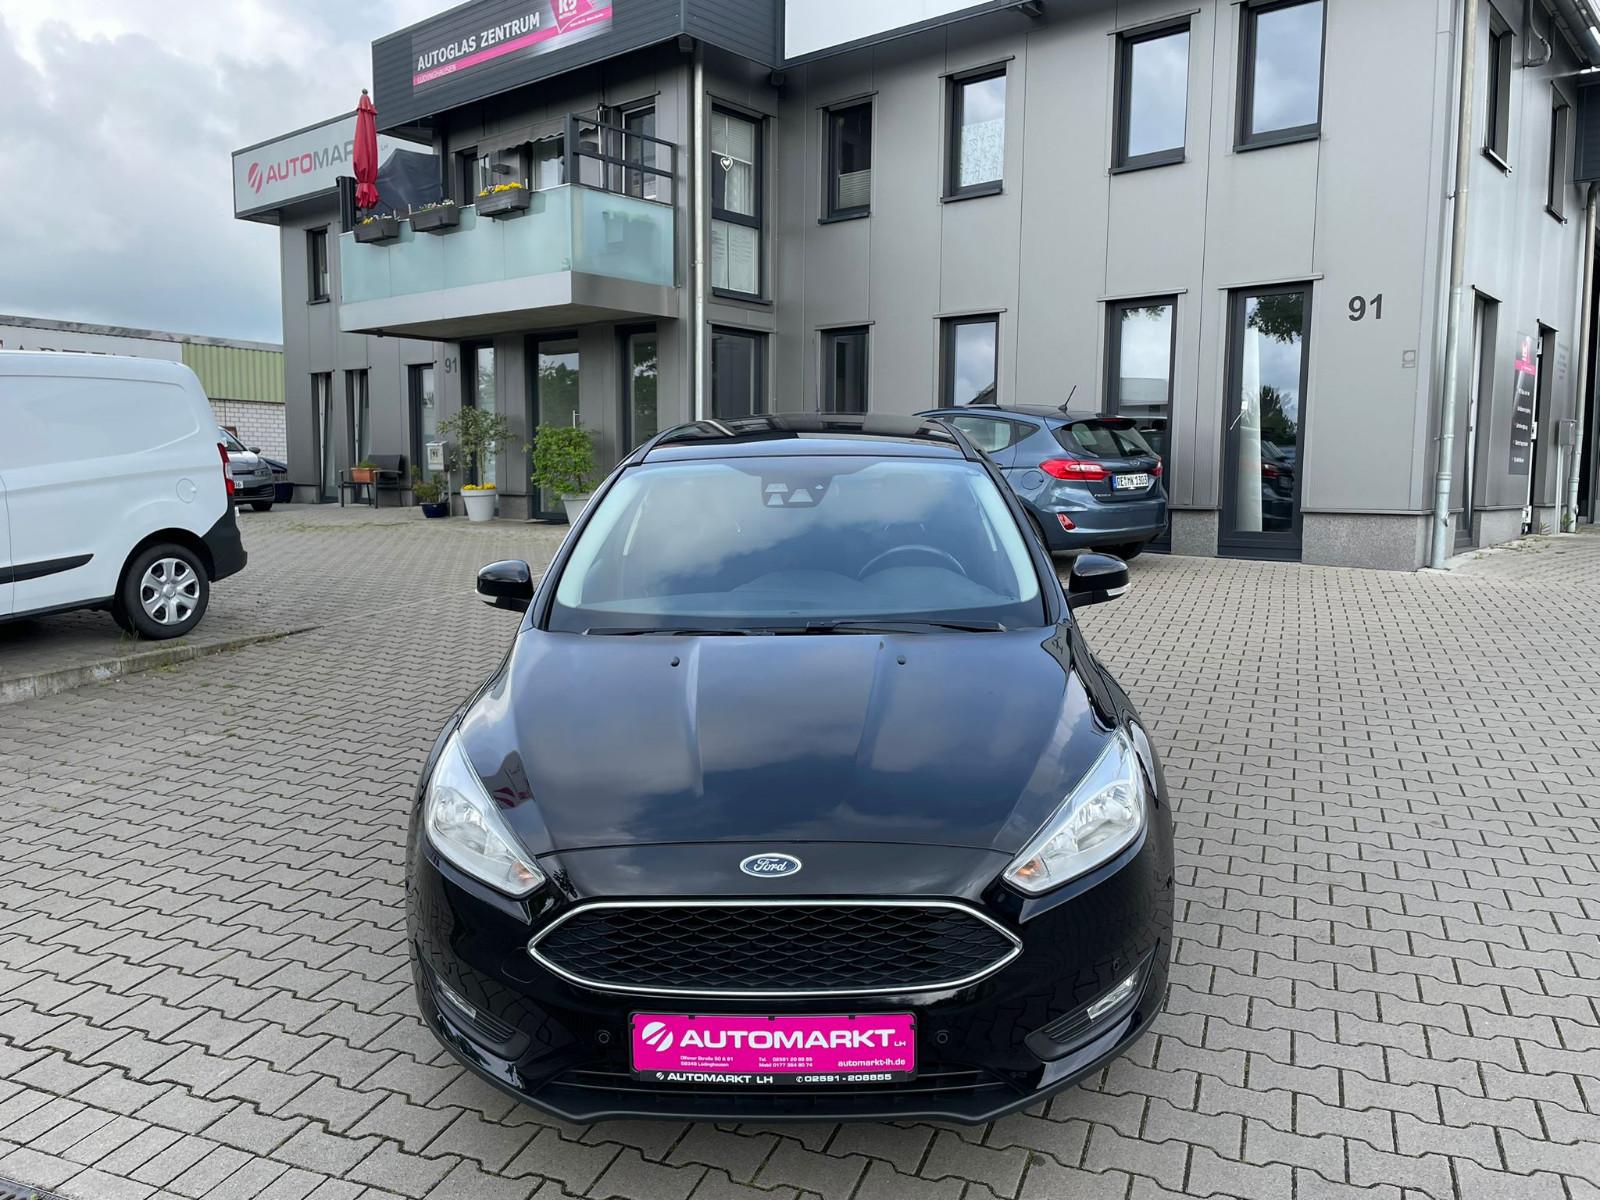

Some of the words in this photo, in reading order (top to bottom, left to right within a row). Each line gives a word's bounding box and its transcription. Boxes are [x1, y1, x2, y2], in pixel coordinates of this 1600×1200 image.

[417, 35, 476, 71] AUTOGLAS
[480, 12, 540, 47] ZENTRUM
[1348, 293, 1383, 322] 91
[444, 357, 457, 374] 91
[753, 858, 787, 871] Ford
[680, 1029, 896, 1049] AUTOMARKT
[838, 1058, 906, 1067] automarkt-lh.de
[667, 1072, 751, 1084] AUTOMARKT
[756, 1075, 773, 1084] LH
